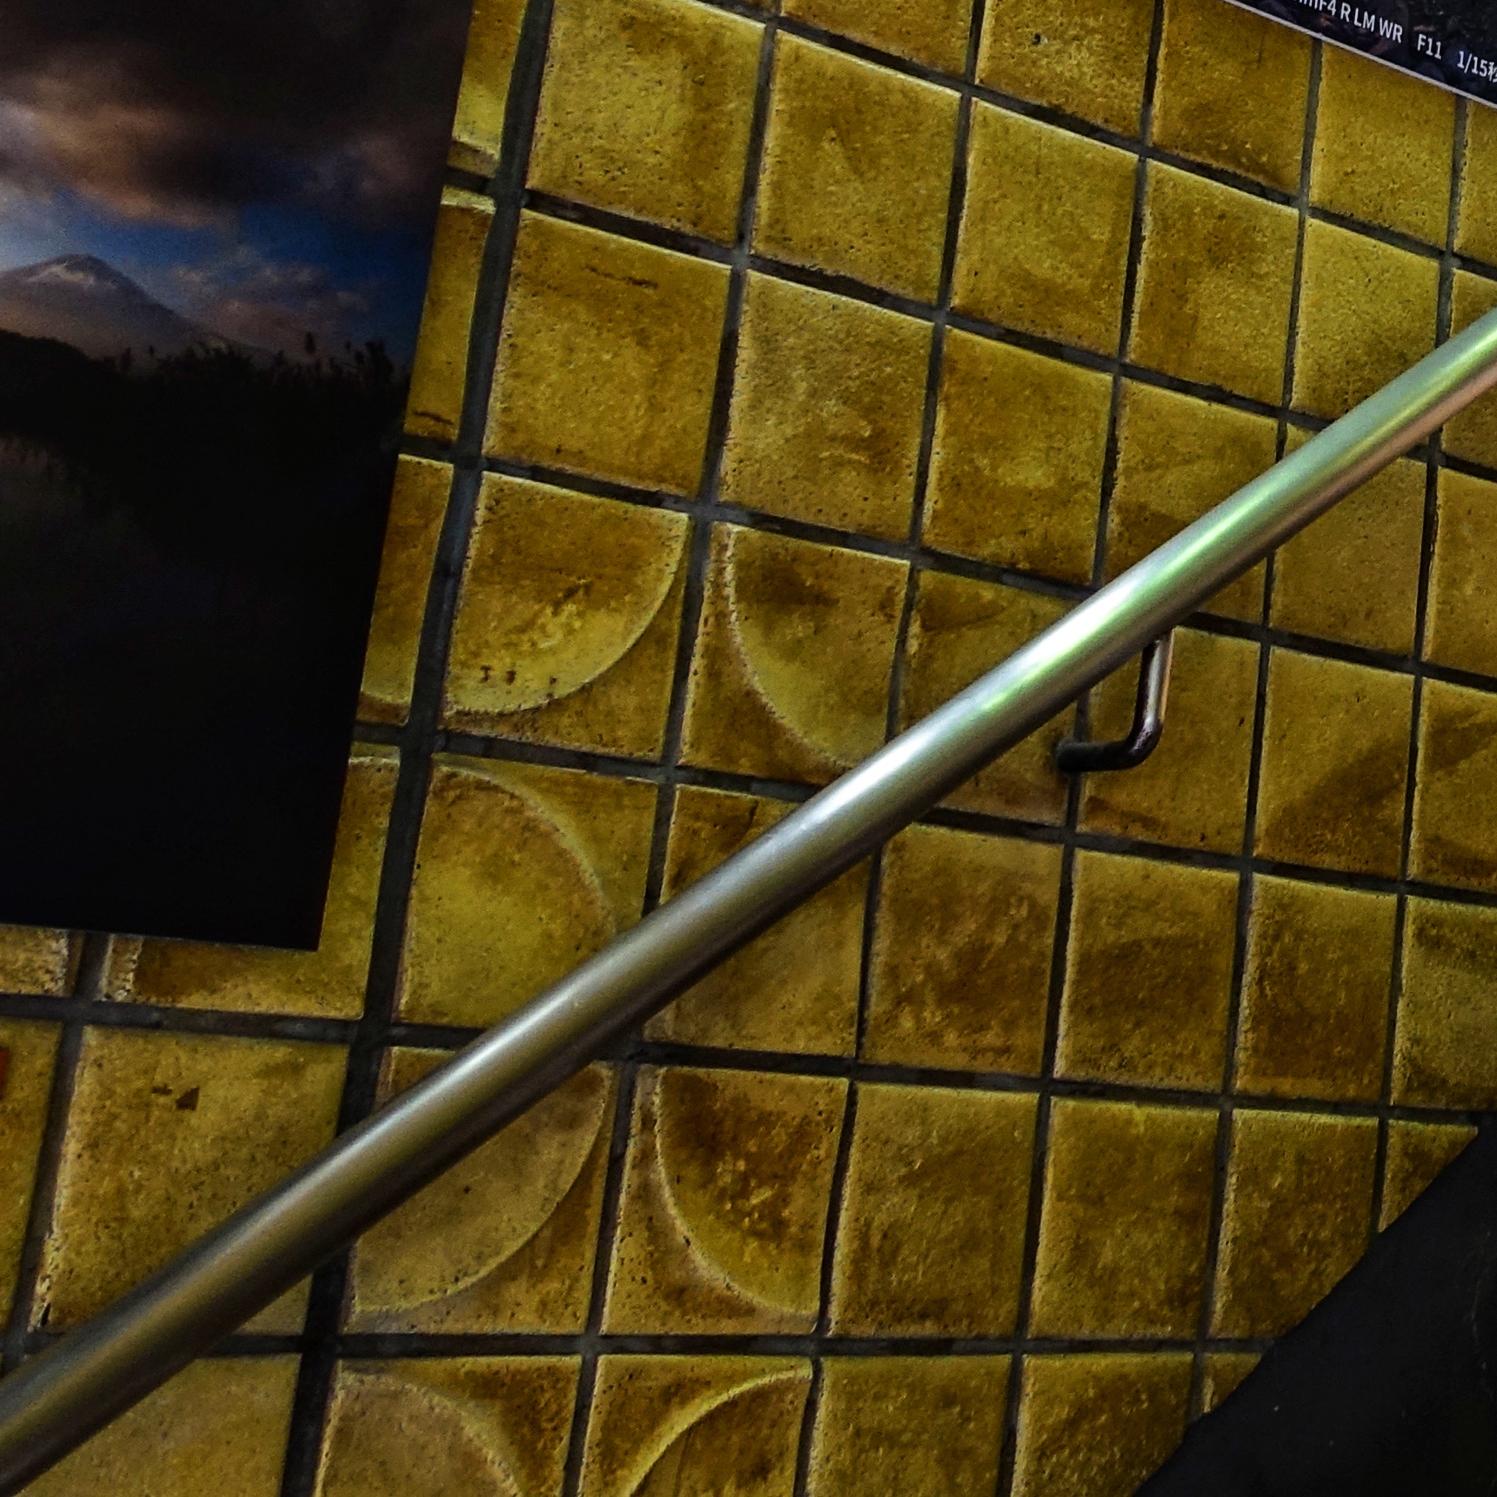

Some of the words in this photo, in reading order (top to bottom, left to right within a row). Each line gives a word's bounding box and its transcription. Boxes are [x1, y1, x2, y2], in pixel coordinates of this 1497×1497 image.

[1340, 2, 1351, 23] R
[1354, 7, 1375, 33] LM
[1379, 18, 1403, 43] WR
[1417, 33, 1442, 60] F11
